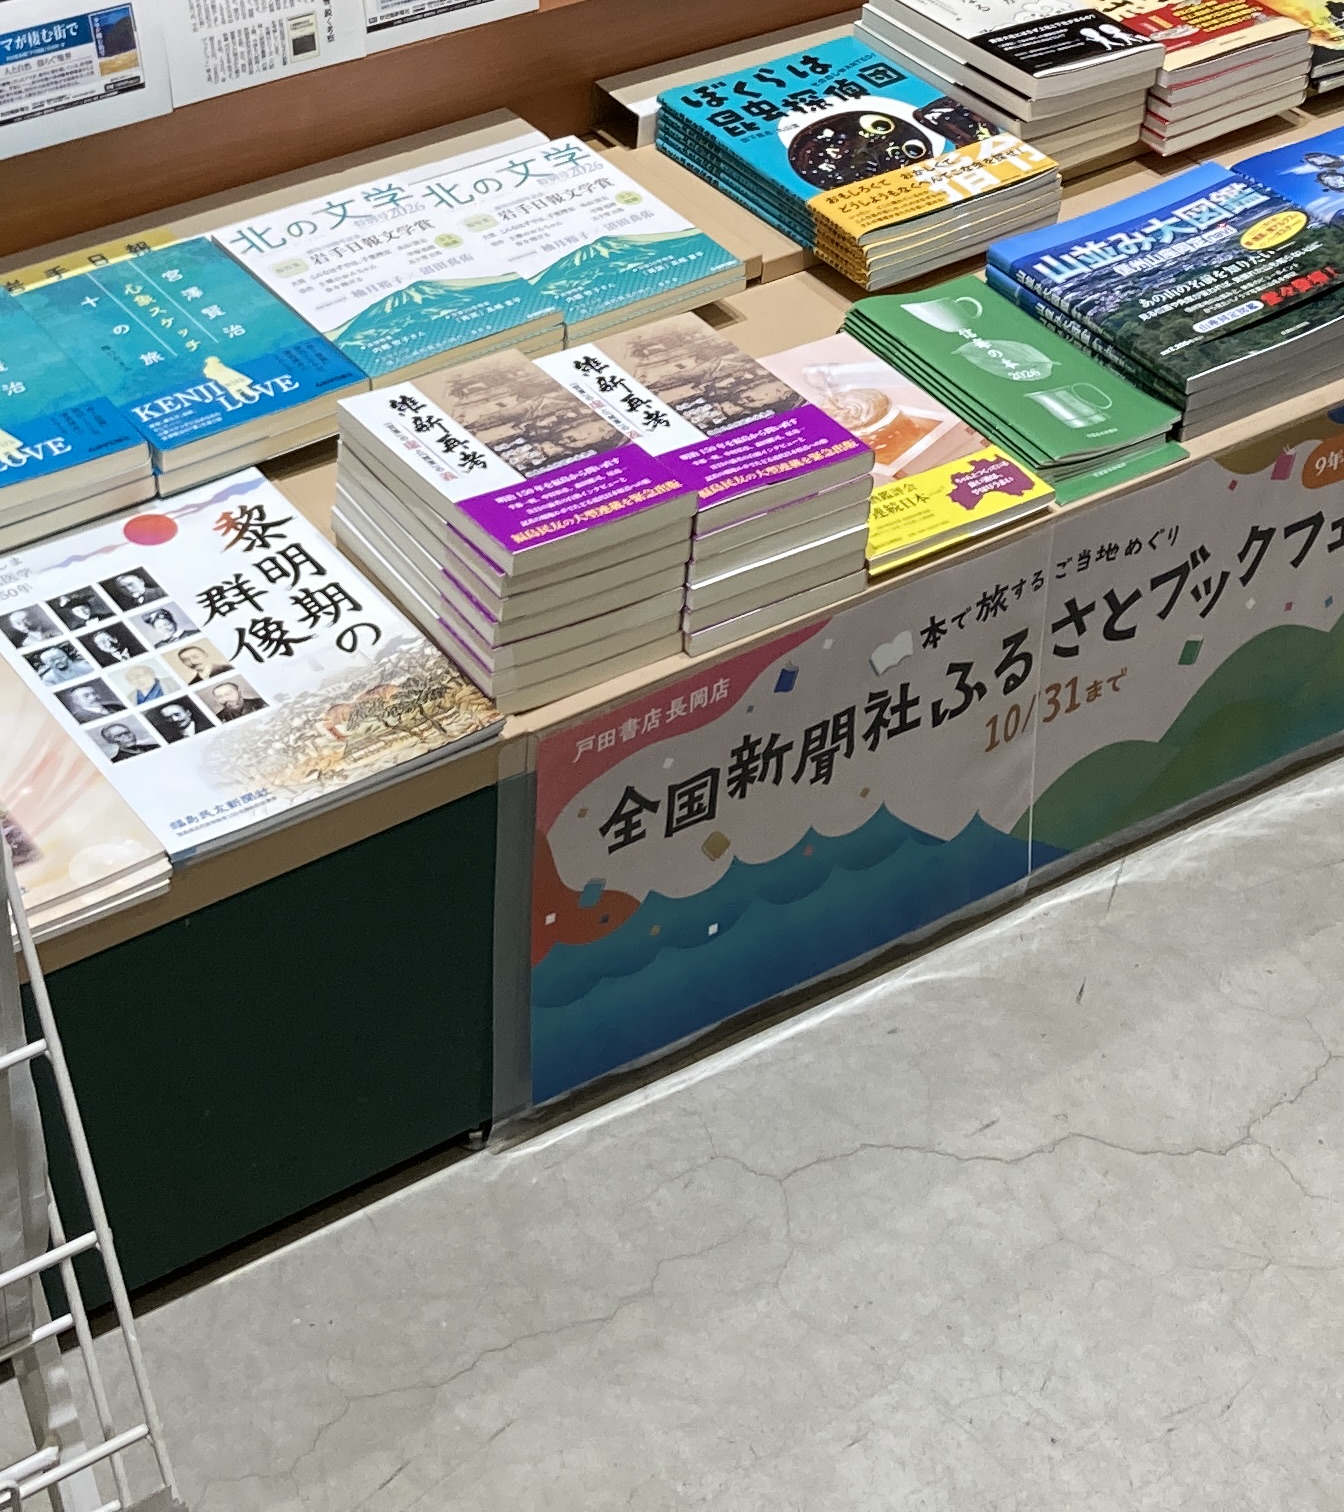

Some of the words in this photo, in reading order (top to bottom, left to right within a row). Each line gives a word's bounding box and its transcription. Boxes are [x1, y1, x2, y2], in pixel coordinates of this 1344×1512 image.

[681, 54, 832, 109] ぼくらは
[705, 61, 910, 141] 昆虫探偵団
[421, 142, 597, 211] 北の文学
[496, 176, 616, 225] 岩手日報文学賞
[825, 178, 892, 205] おもしろくて
[229, 181, 419, 256] 北の文学
[307, 219, 437, 267] 岩手日報文学賞
[1033, 181, 1270, 283] 山並み大図鑑
[122, 282, 202, 357] 心象スケッチ
[160, 266, 248, 343] 宮澤賢治
[132, 385, 227, 426] KENJI
[216, 371, 302, 413] LOVE
[572, 354, 672, 432] 維新再考
[1008, 368, 1041, 381] 2026
[387, 394, 490, 476] 維新再考
[212, 503, 383, 655] 黎明期の
[920, 524, 1183, 651] 本で旅するご当地めぐり
[194, 577, 313, 667] 群像
[573, 678, 731, 763] 戸田書店長岡店
[984, 668, 1129, 754] 10/31まで
